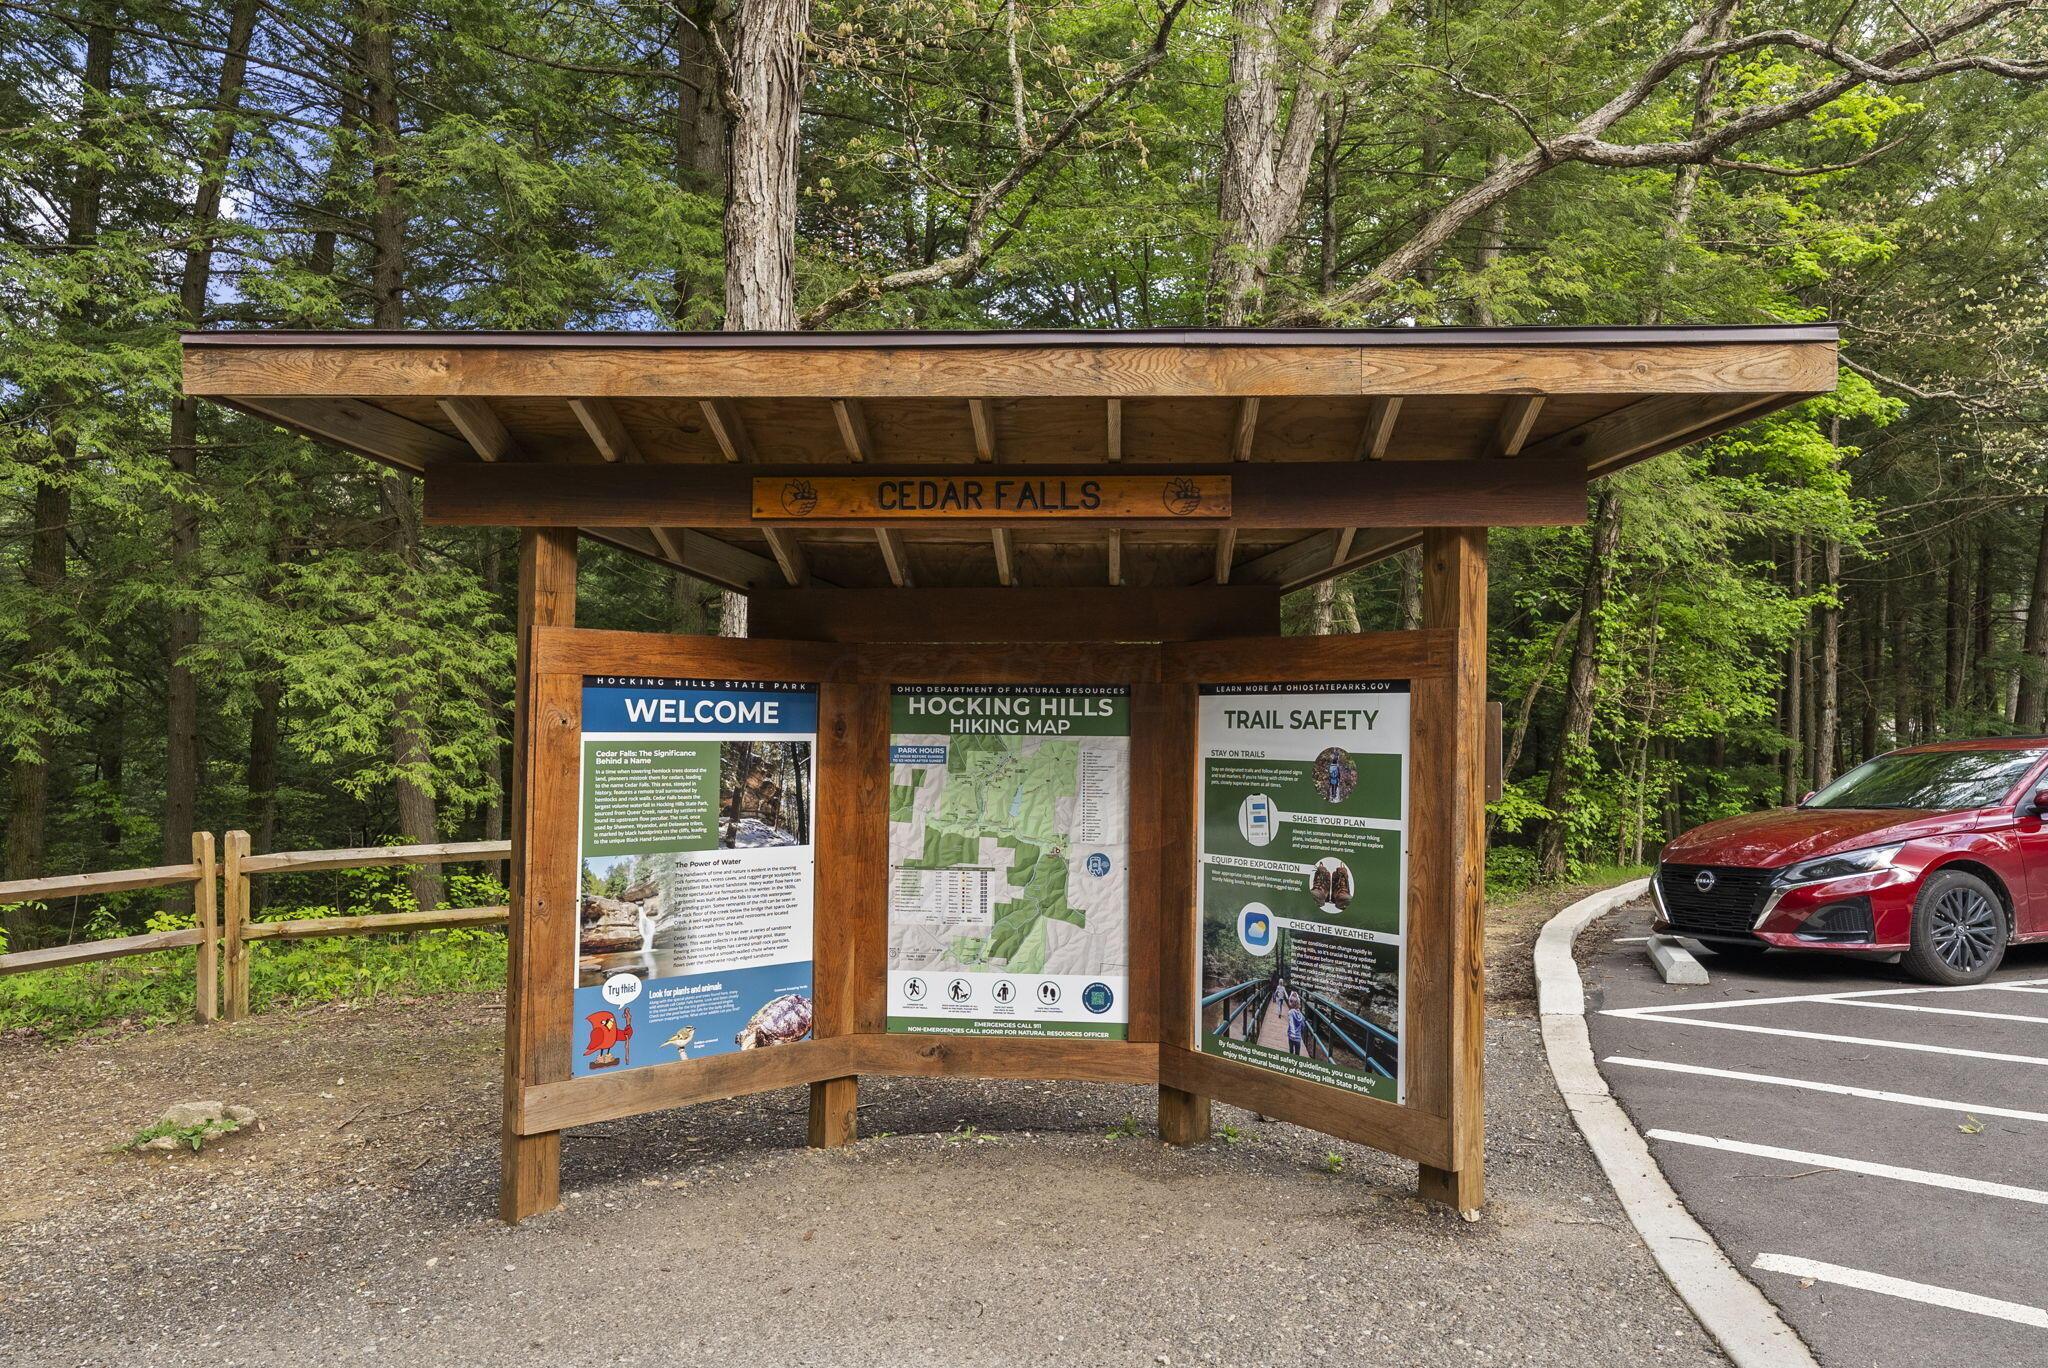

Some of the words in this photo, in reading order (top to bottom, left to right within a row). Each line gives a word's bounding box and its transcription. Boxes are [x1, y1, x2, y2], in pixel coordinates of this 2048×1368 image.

[878, 480, 981, 510] CEDAR
[994, 480, 1100, 510] FALLS
[625, 698, 778, 723] WELCOME
[909, 697, 1029, 714] HOCKING
[1040, 698, 1113, 716] HILLS
[950, 719, 1018, 732] HIKING
[1026, 720, 1069, 733] MAP
[1224, 710, 1283, 728] TRAIL
[1289, 710, 1377, 729] SAFETY
[1292, 814, 1318, 823] SHARE
[1319, 816, 1342, 825] YOUR
[1343, 818, 1365, 827] PLAN
[1211, 856, 1232, 865] EQUIP
[1233, 858, 1248, 867] FOR
[1249, 860, 1300, 873] EXPLORATION
[1289, 920, 1315, 931] CHECK
[1317, 925, 1332, 934] THE
[1334, 927, 1374, 940] WEATHER
[608, 984, 619, 996] Try
[621, 983, 635, 993] this!
[648, 989, 663, 998] Look
[663, 988, 672, 996] for
[672, 985, 690, 997] plants
[690, 984, 701, 993] and
[701, 981, 722, 992] animals
[1218, 1039, 1225, 1047] By
[1226, 1041, 1250, 1054] following
[1251, 1048, 1267, 1057] these
[1268, 1052, 1279, 1060] trail
[1280, 1055, 1297, 1066] safety
[1298, 1059, 1330, 1074] guidelines,
[1331, 1069, 1342, 1078] you
[1357, 1074, 1375, 1086] safely
[1222, 1049, 1237, 1059] enjoy
[1248, 1056, 1267, 1066] natural
[1268, 1061, 1288, 1073] beauty
[1296, 1068, 1320, 1081] Hocking
[1322, 1075, 1334, 1084] Hills
[1336, 1078, 1351, 1088] State
[1353, 1083, 1369, 1093] Park.
